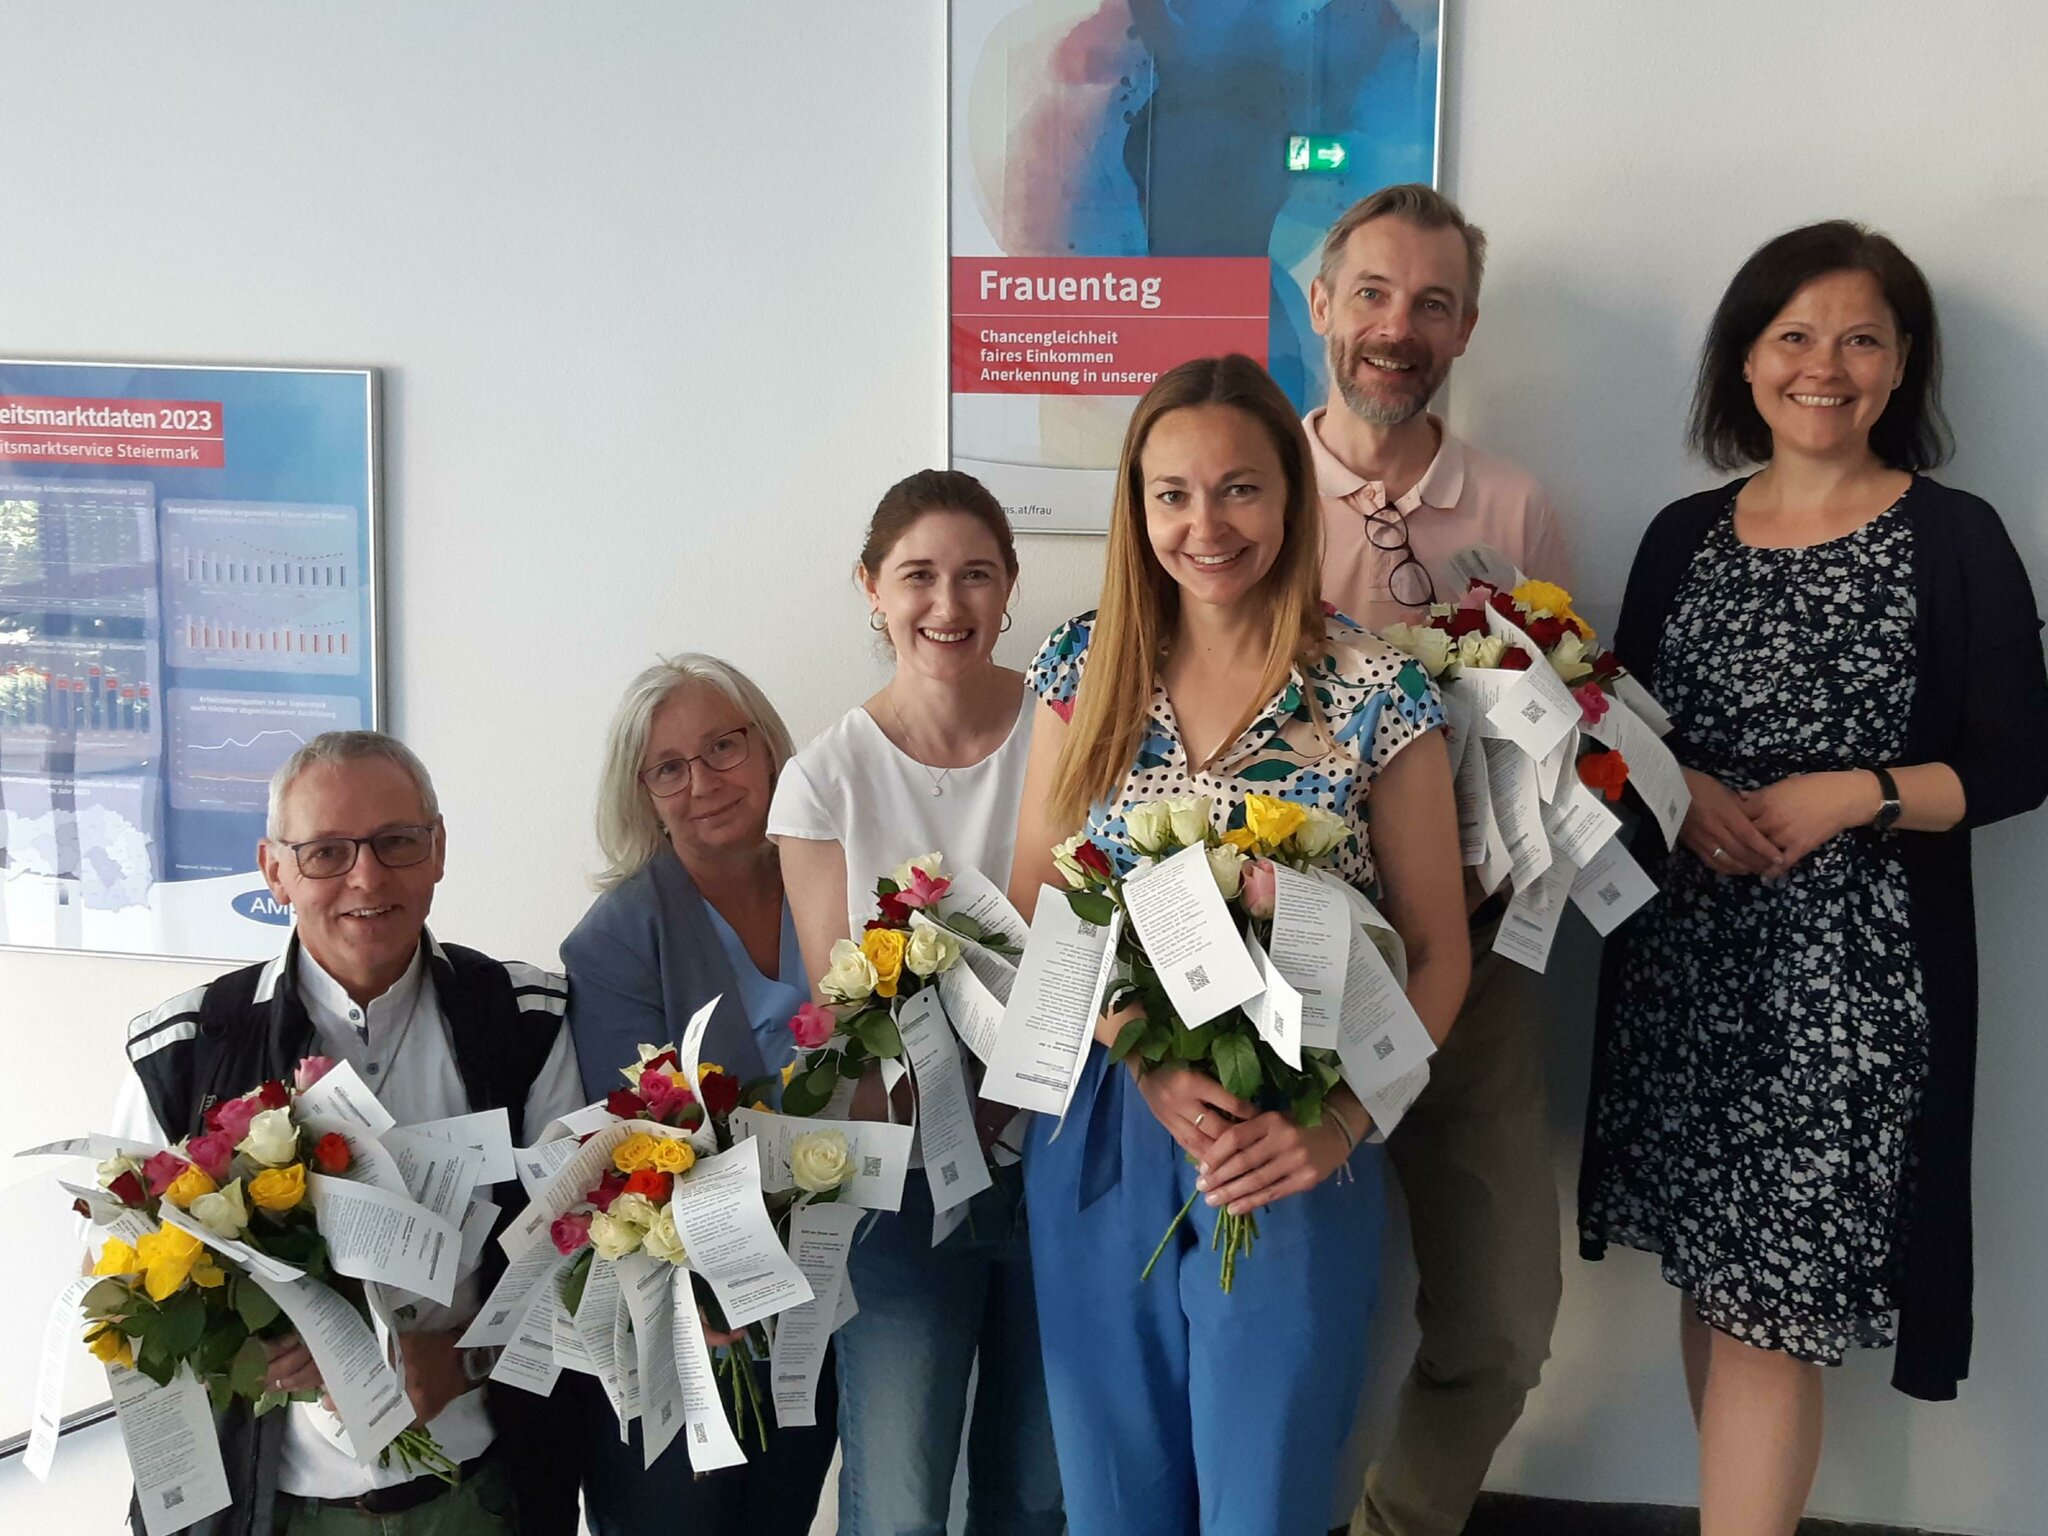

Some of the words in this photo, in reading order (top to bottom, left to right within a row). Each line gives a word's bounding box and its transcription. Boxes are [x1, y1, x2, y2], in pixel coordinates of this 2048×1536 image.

[980, 270, 1162, 309] Frauentag
[980, 329, 1119, 346] Chancengleichheit
[980, 348, 1023, 363] faires
[1026, 349, 1114, 363] Einkommen
[980, 367, 1080, 385] Anerkennung
[1083, 368, 1098, 383] in
[1101, 371, 1159, 383] unserer
[0, 403, 157, 430] eitsmarktdaten
[159, 409, 213, 431] 2023
[117, 443, 200, 460] Steiermark
[1001, 504, 1053, 516] ms.at/frau
[249, 896, 289, 916] AM
